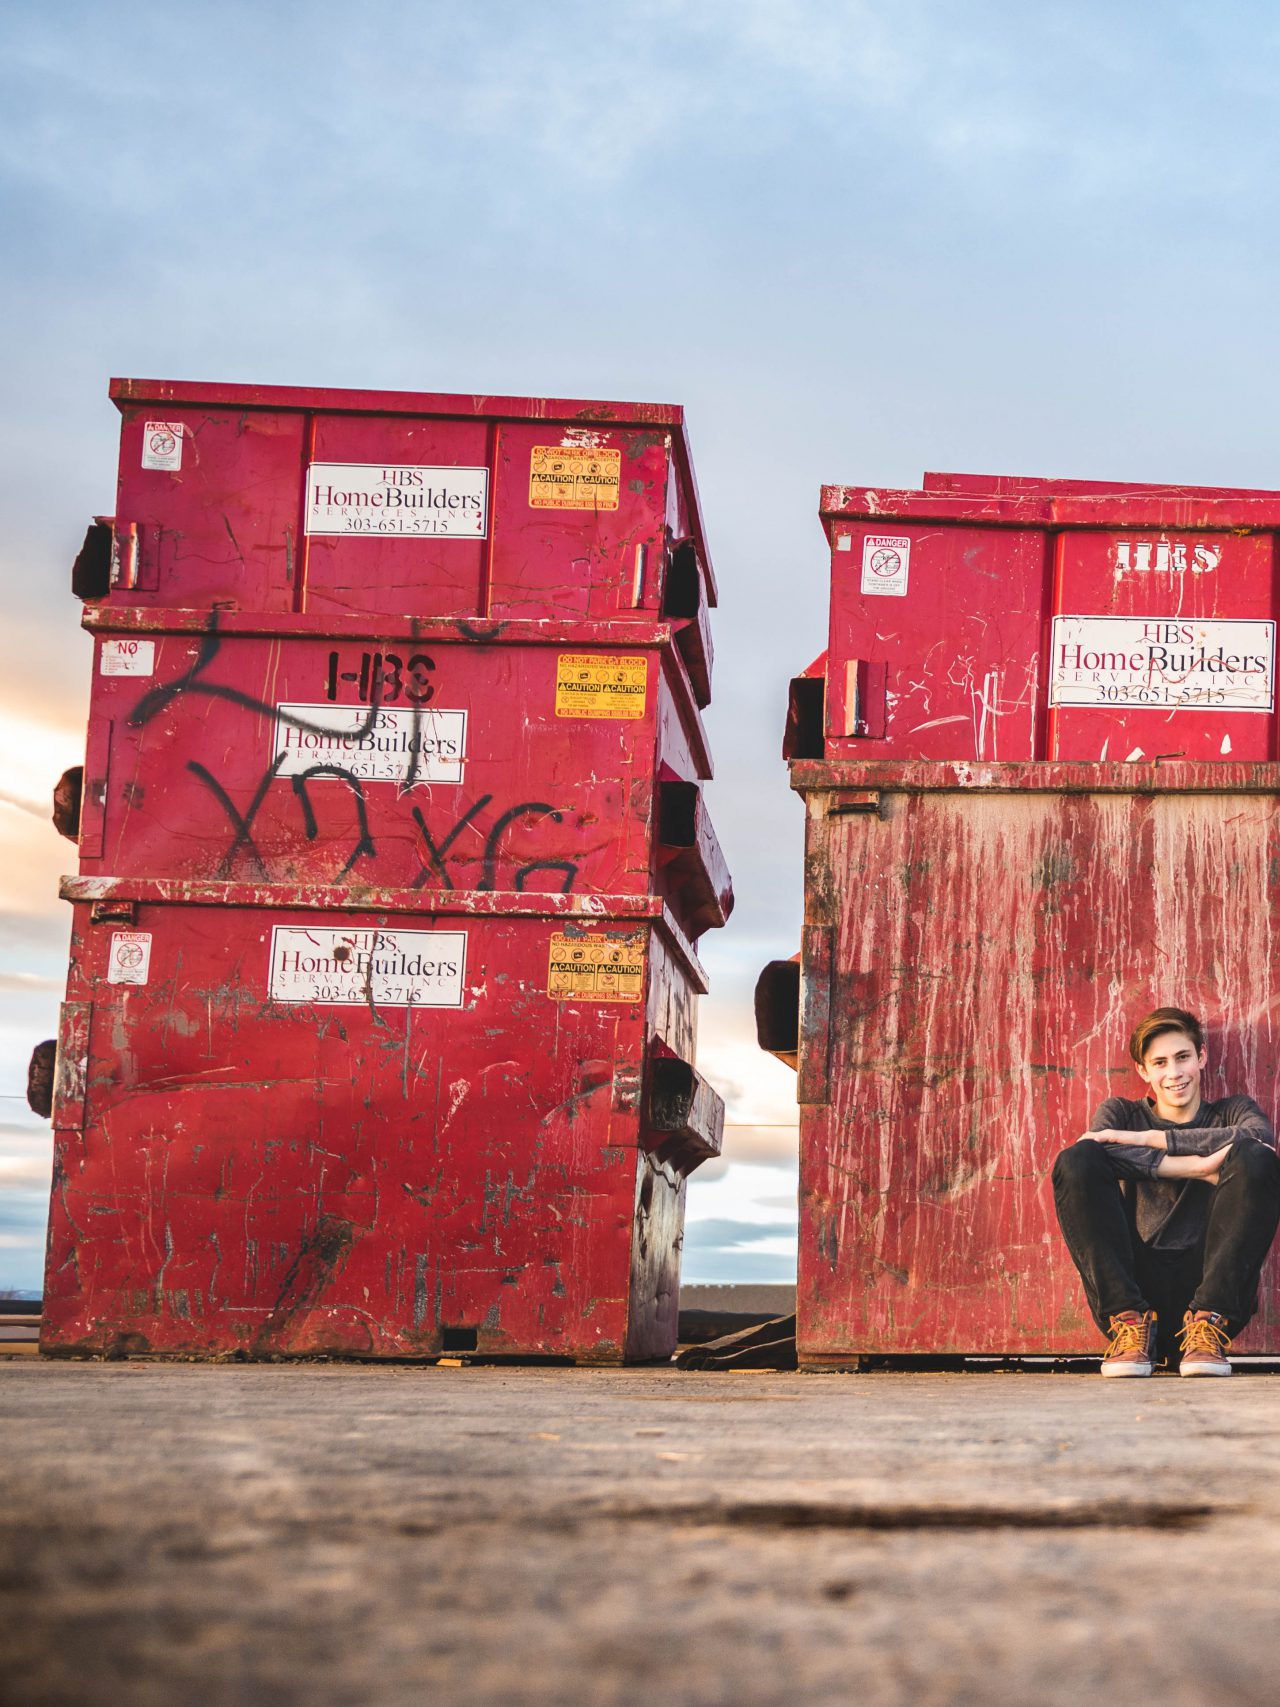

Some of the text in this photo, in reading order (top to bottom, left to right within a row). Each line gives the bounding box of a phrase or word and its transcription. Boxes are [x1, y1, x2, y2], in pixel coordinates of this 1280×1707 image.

[382, 470, 423, 486] HBS
[539, 475, 618, 484] CAUTION CAUTION
[313, 485, 481, 510] HomeBuilders
[344, 518, 449, 532] 303-651-5715
[875, 538, 907, 548] DANGER
[1143, 623, 1194, 644] HBS
[118, 641, 138, 654] NO
[1059, 643, 1267, 674] HomeBuilders
[566, 684, 645, 693] CAUTION CAUTION
[1097, 684, 1225, 704] 303-651-5715
[355, 712, 398, 729] HBS
[284, 728, 457, 754] HomeBuilders
[353, 933, 398, 952] HBS
[281, 951, 457, 977] HomeBuilders
[559, 963, 641, 974] CAUTION CAUTION
[313, 986, 422, 1002] 303-65-5715
